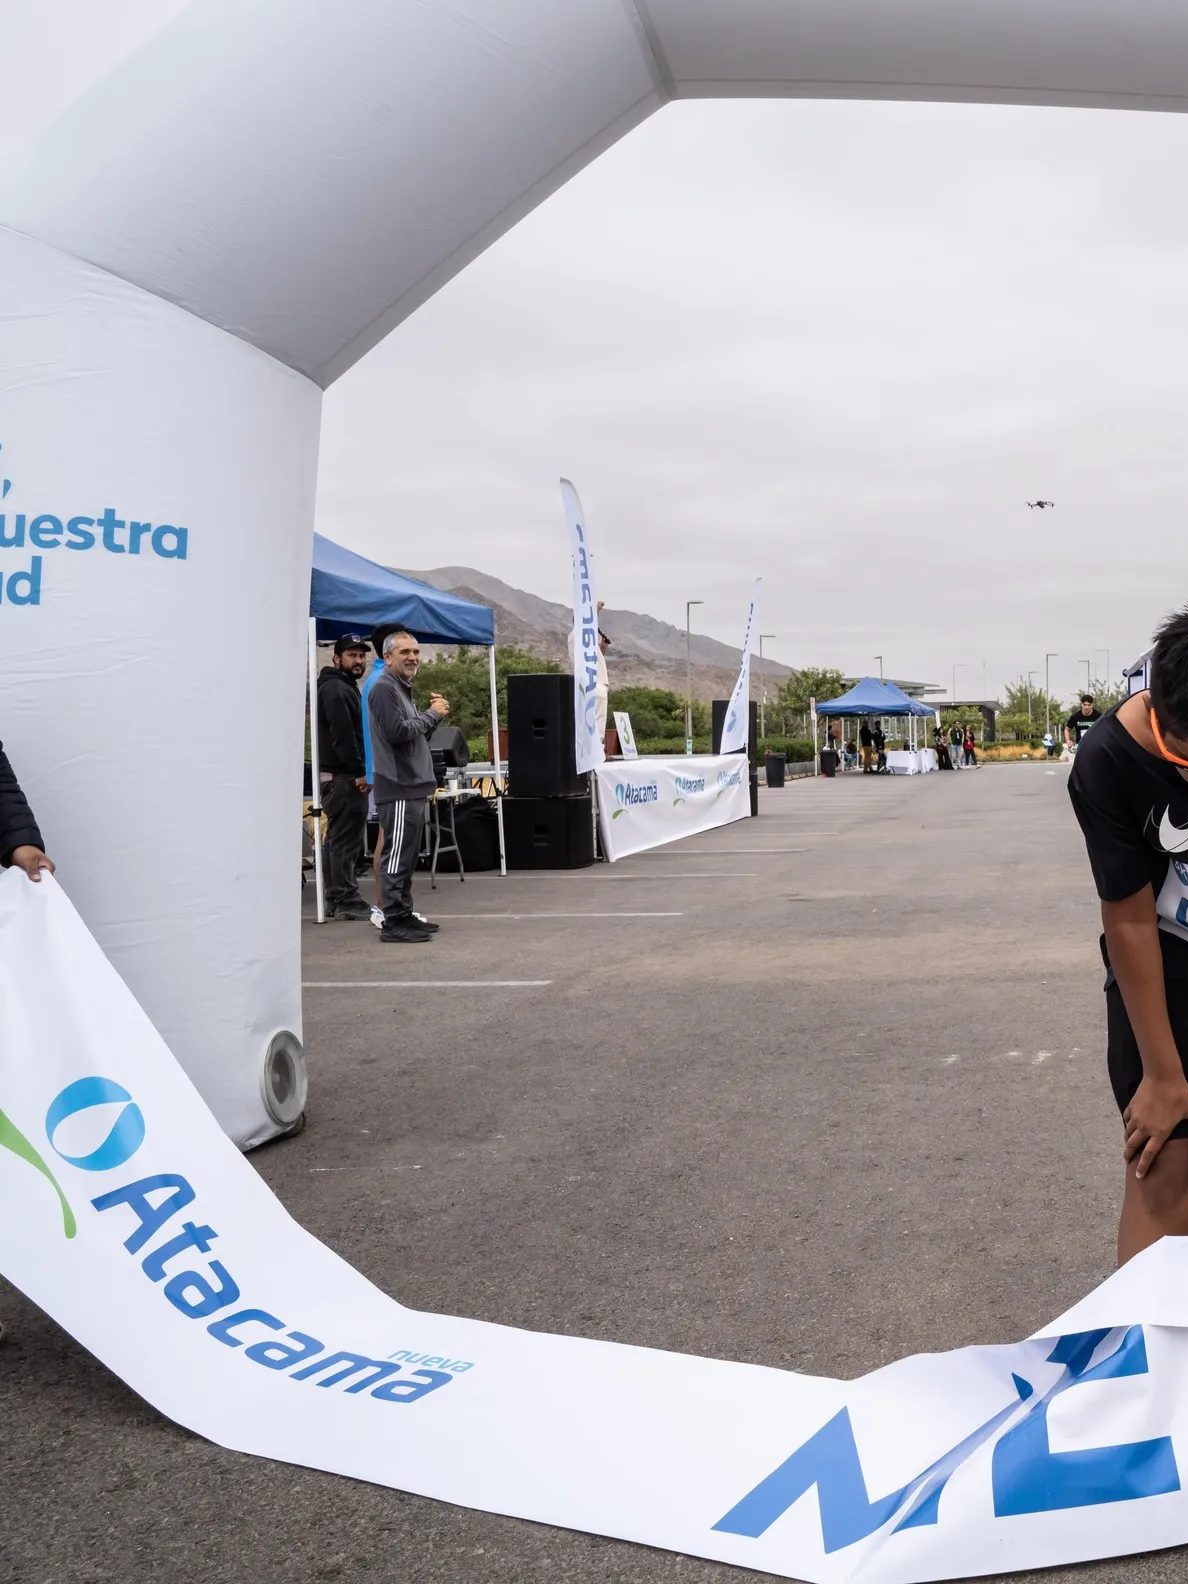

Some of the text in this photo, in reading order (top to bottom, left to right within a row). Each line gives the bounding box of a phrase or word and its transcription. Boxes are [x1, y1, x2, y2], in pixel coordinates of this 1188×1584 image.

[624, 782, 658, 806] Atacama
[90, 1173, 454, 1404] Atacama
[386, 1349, 475, 1373] nueva
